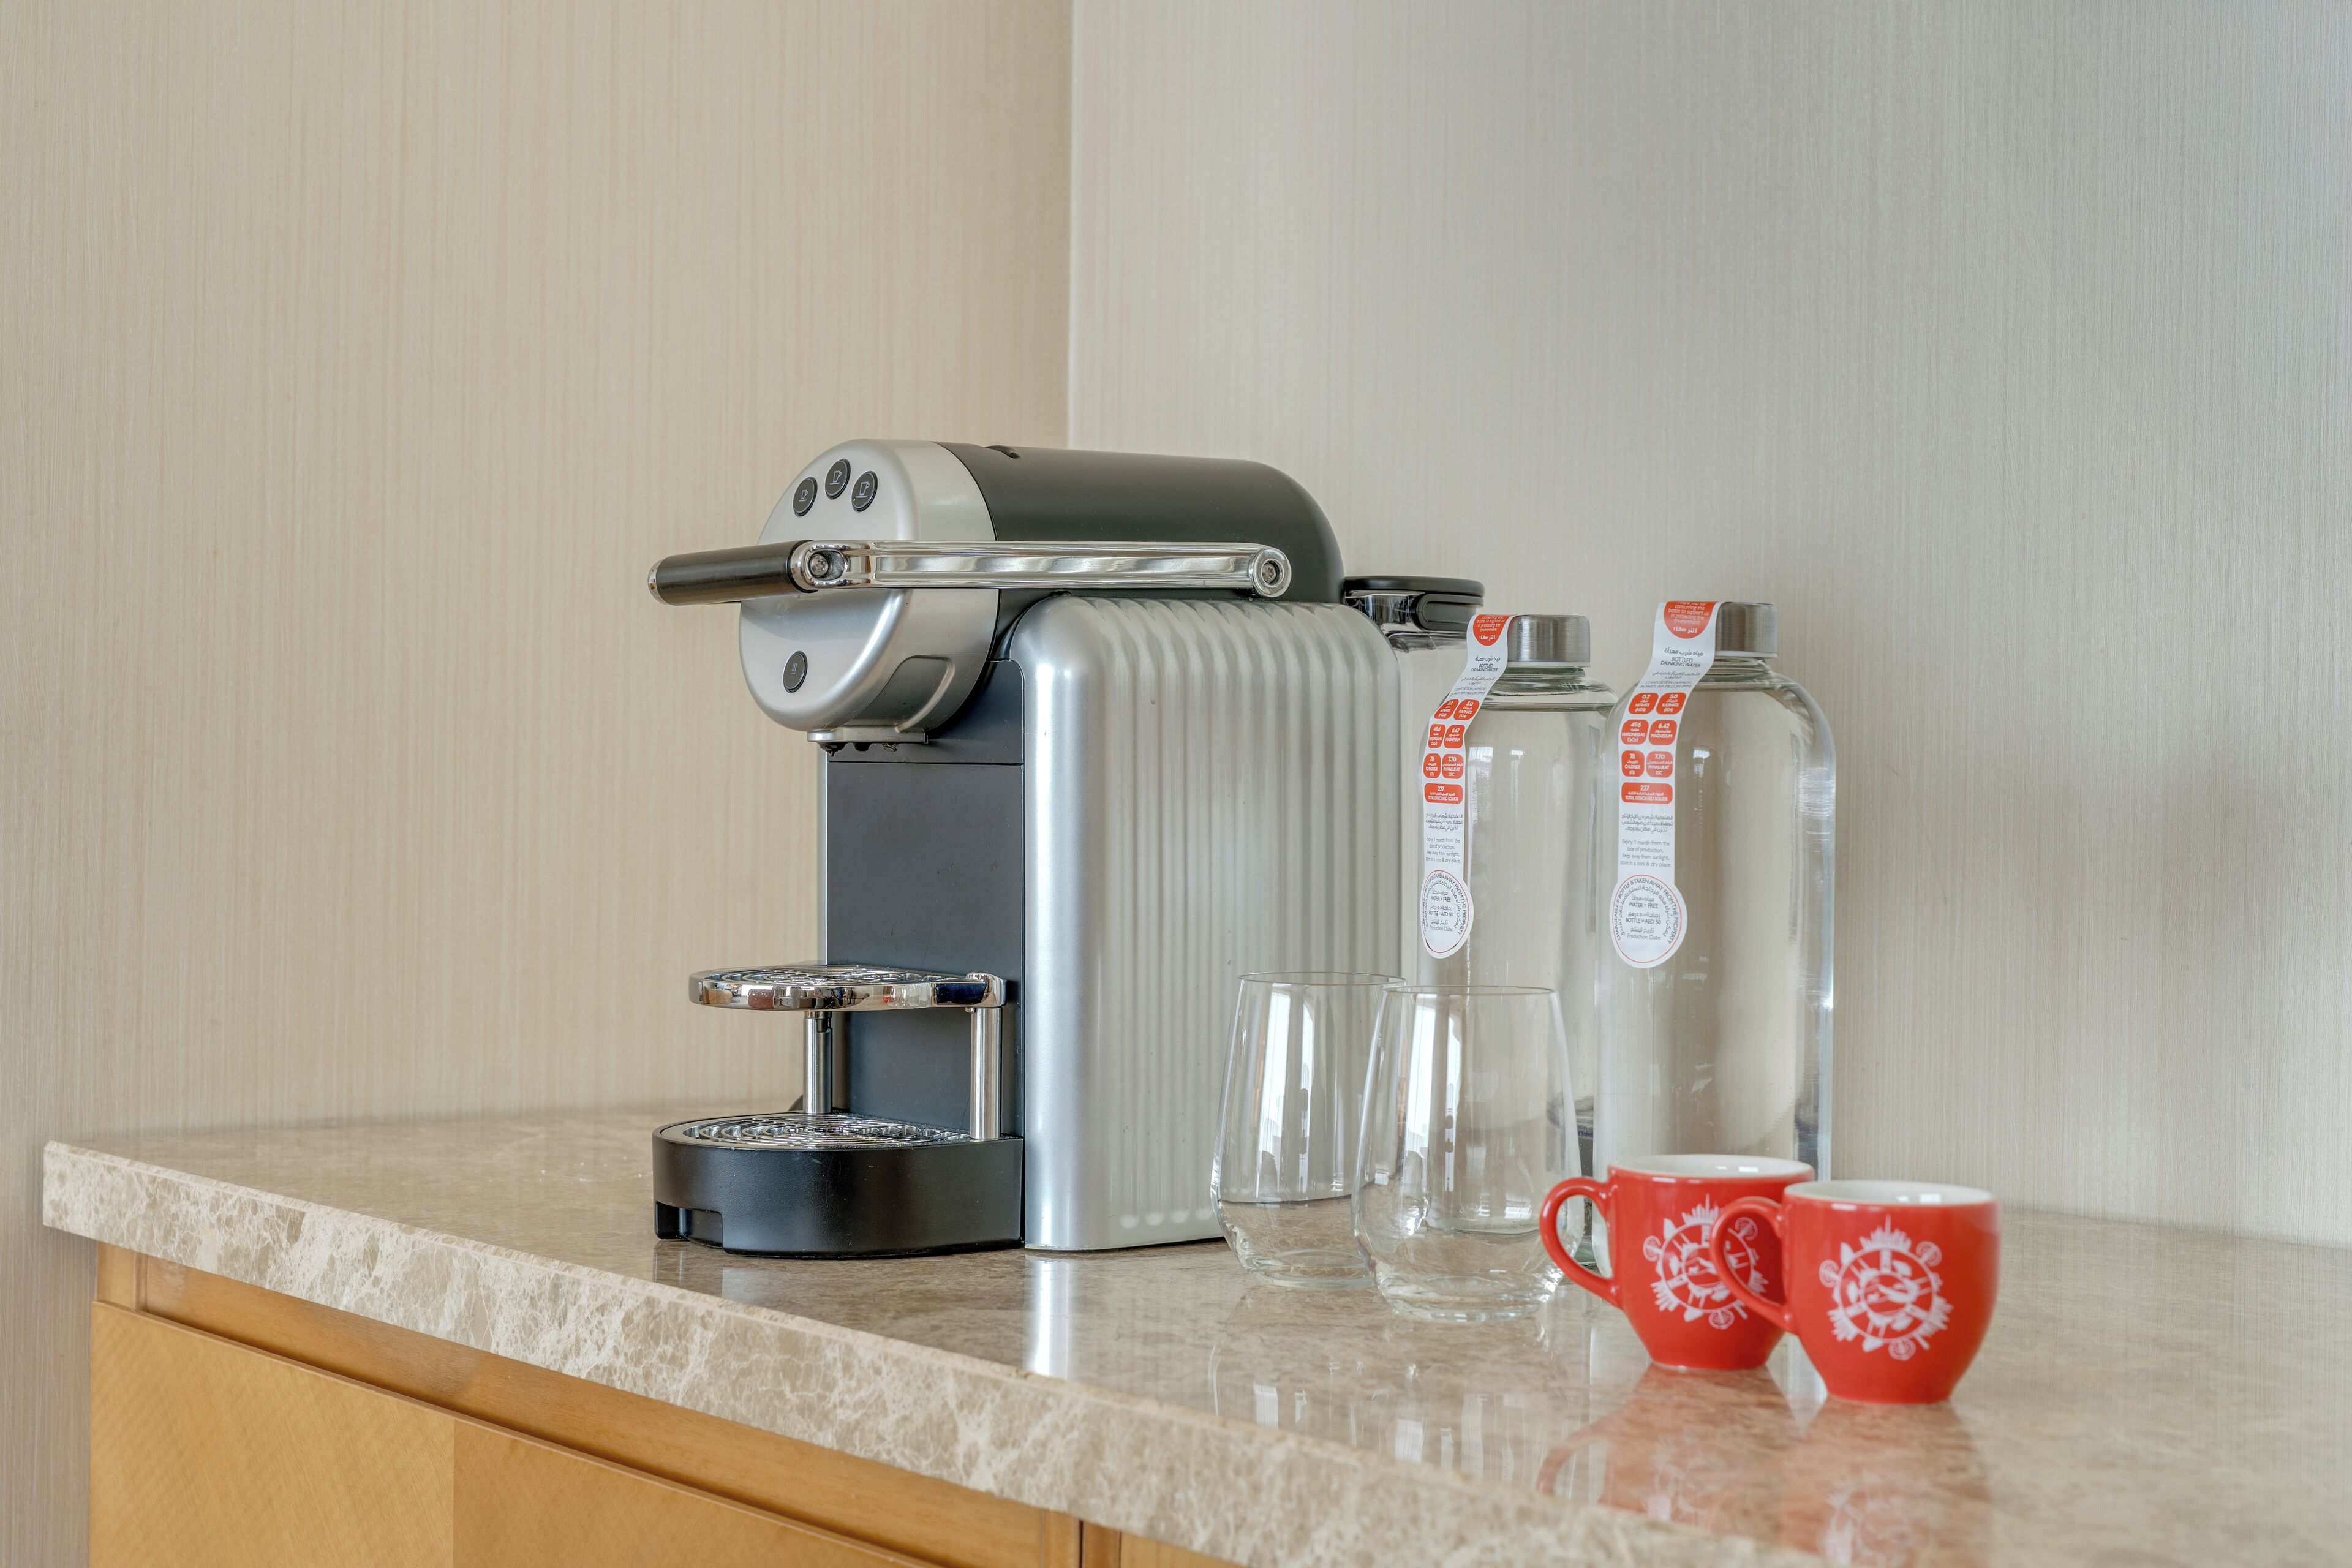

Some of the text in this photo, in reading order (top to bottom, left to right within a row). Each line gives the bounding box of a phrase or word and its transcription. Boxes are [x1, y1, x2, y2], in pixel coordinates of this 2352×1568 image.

[1444, 874, 1455, 884] AWAY
[1649, 880, 1664, 891] AWAY
[1454, 883, 1463, 897] FROM
[1618, 883, 1630, 899] BOTTLE
[1663, 889, 1675, 905] FROM
[1458, 910, 1467, 936] PROPERTY
[1667, 917, 1679, 944] PROPERTY
